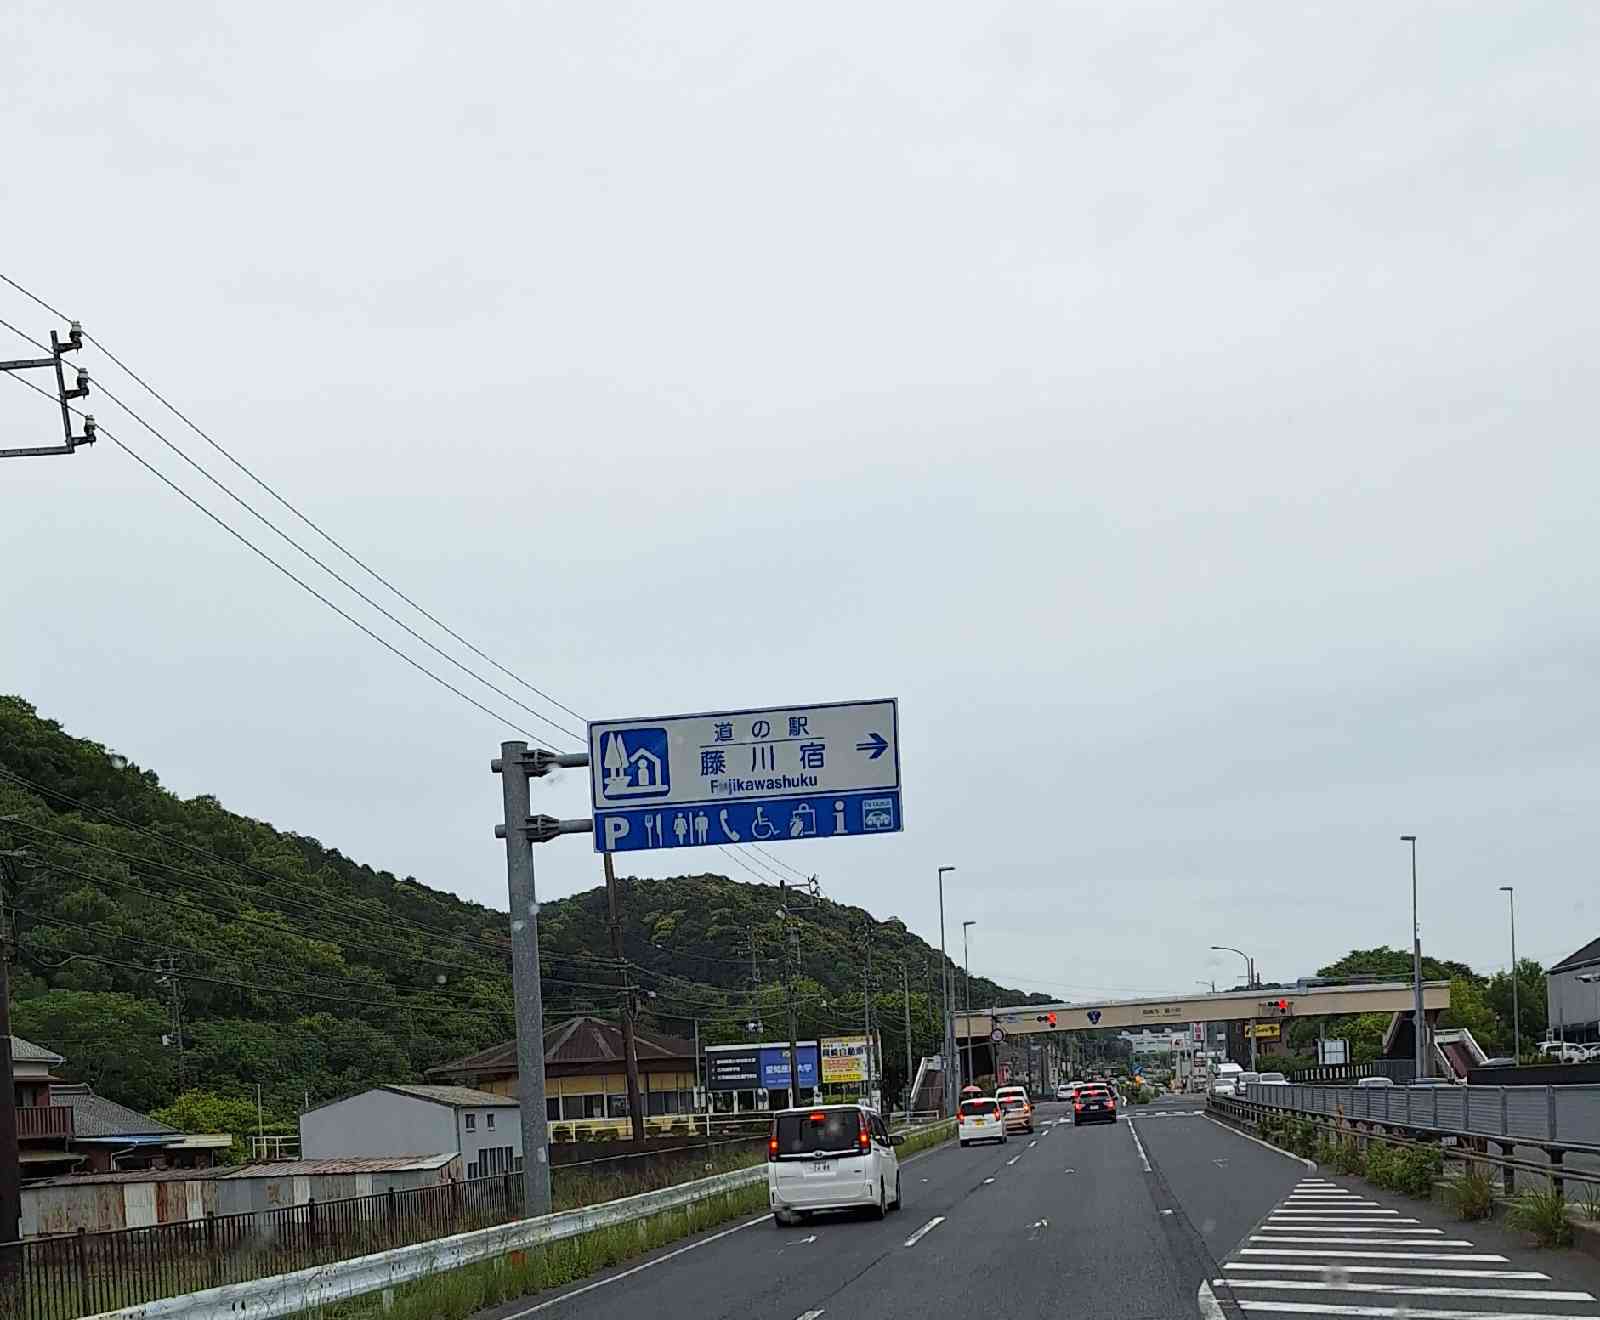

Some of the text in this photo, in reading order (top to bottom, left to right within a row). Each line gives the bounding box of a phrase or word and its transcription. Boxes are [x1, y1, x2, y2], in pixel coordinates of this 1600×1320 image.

[714, 716, 810, 742] 道の駅
[700, 742, 826, 776] 藤川宿
